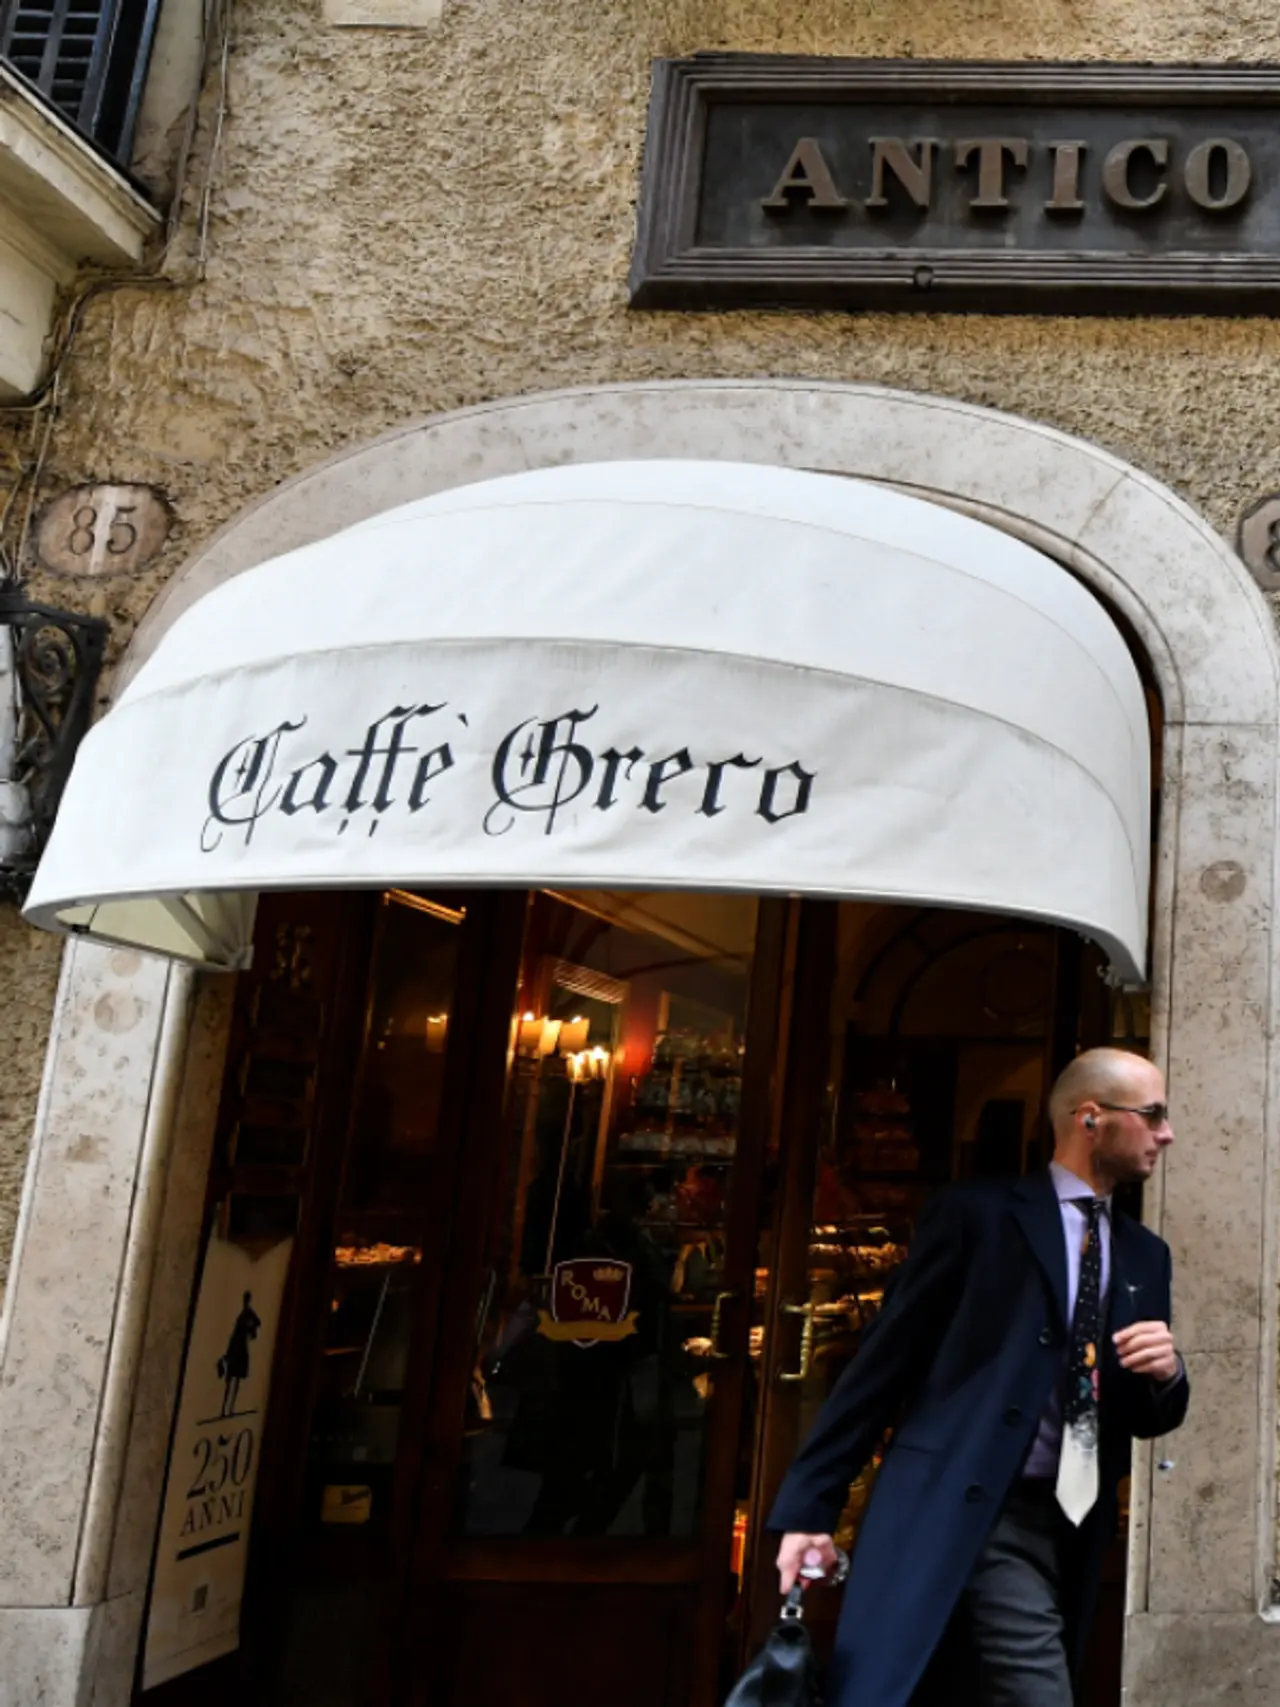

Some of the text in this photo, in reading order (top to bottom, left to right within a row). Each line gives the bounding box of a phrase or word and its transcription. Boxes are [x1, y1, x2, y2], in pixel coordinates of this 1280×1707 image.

[760, 136, 1252, 213] ANTICO
[67, 504, 138, 556] 85
[482, 703, 818, 836] Greco
[560, 1269, 613, 1321] ROMA
[185, 1426, 254, 1501] 250
[179, 1489, 249, 1538] ANNI
